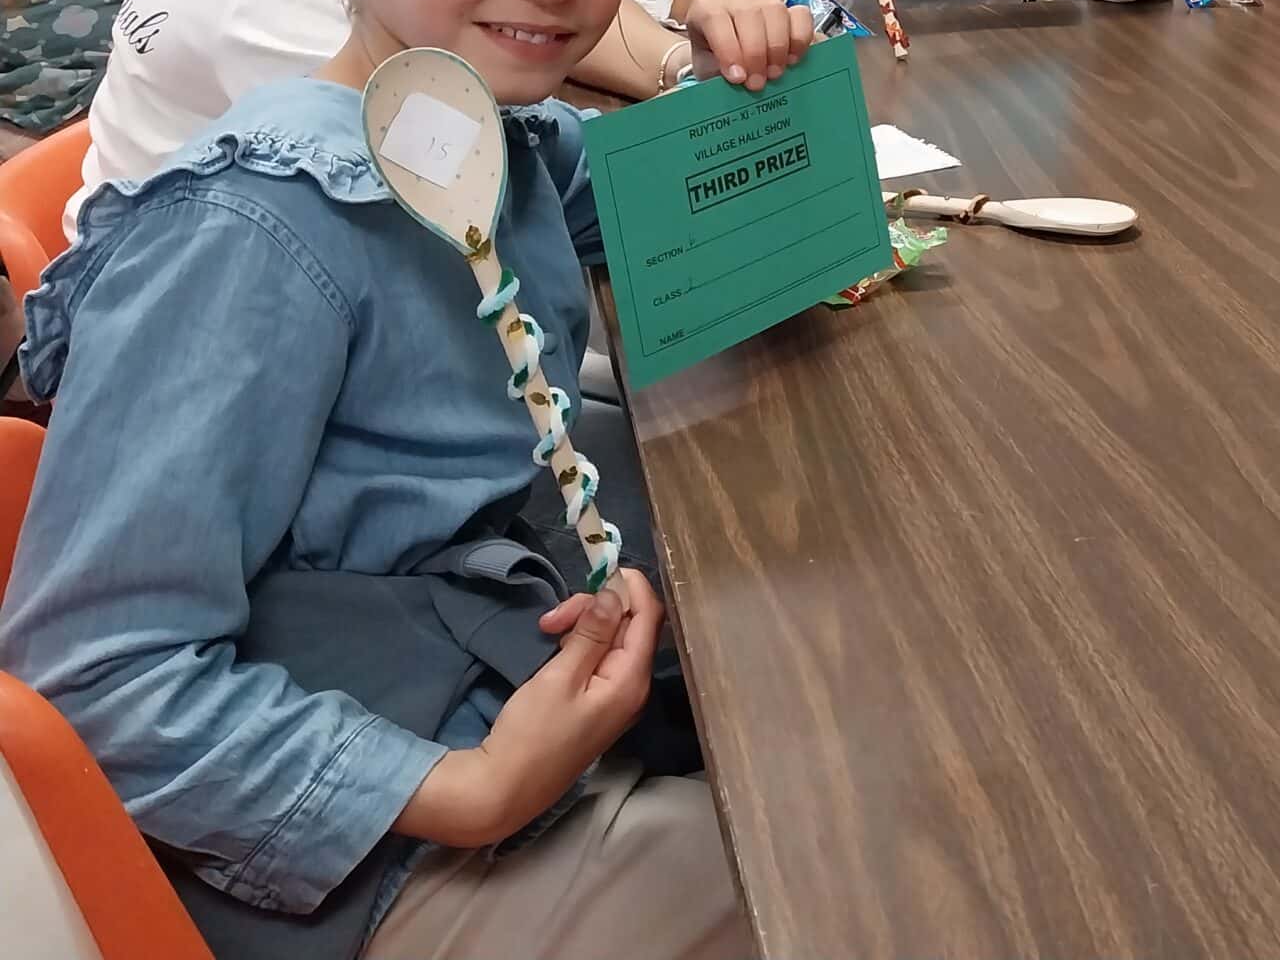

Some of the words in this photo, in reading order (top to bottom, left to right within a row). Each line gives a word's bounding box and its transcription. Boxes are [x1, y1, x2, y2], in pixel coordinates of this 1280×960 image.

[689, 117, 731, 140] RUYTON
[740, 109, 750, 121] XI
[755, 95, 789, 115] TOWNS
[694, 138, 738, 161] VILLAGE
[738, 128, 764, 146] HALL
[764, 118, 792, 136] SHOW
[689, 167, 750, 204] THIRD
[754, 143, 807, 179] PRIZE
[645, 246, 684, 268] SECTION
[653, 289, 682, 307] CLASS
[659, 328, 685, 346] NAME
